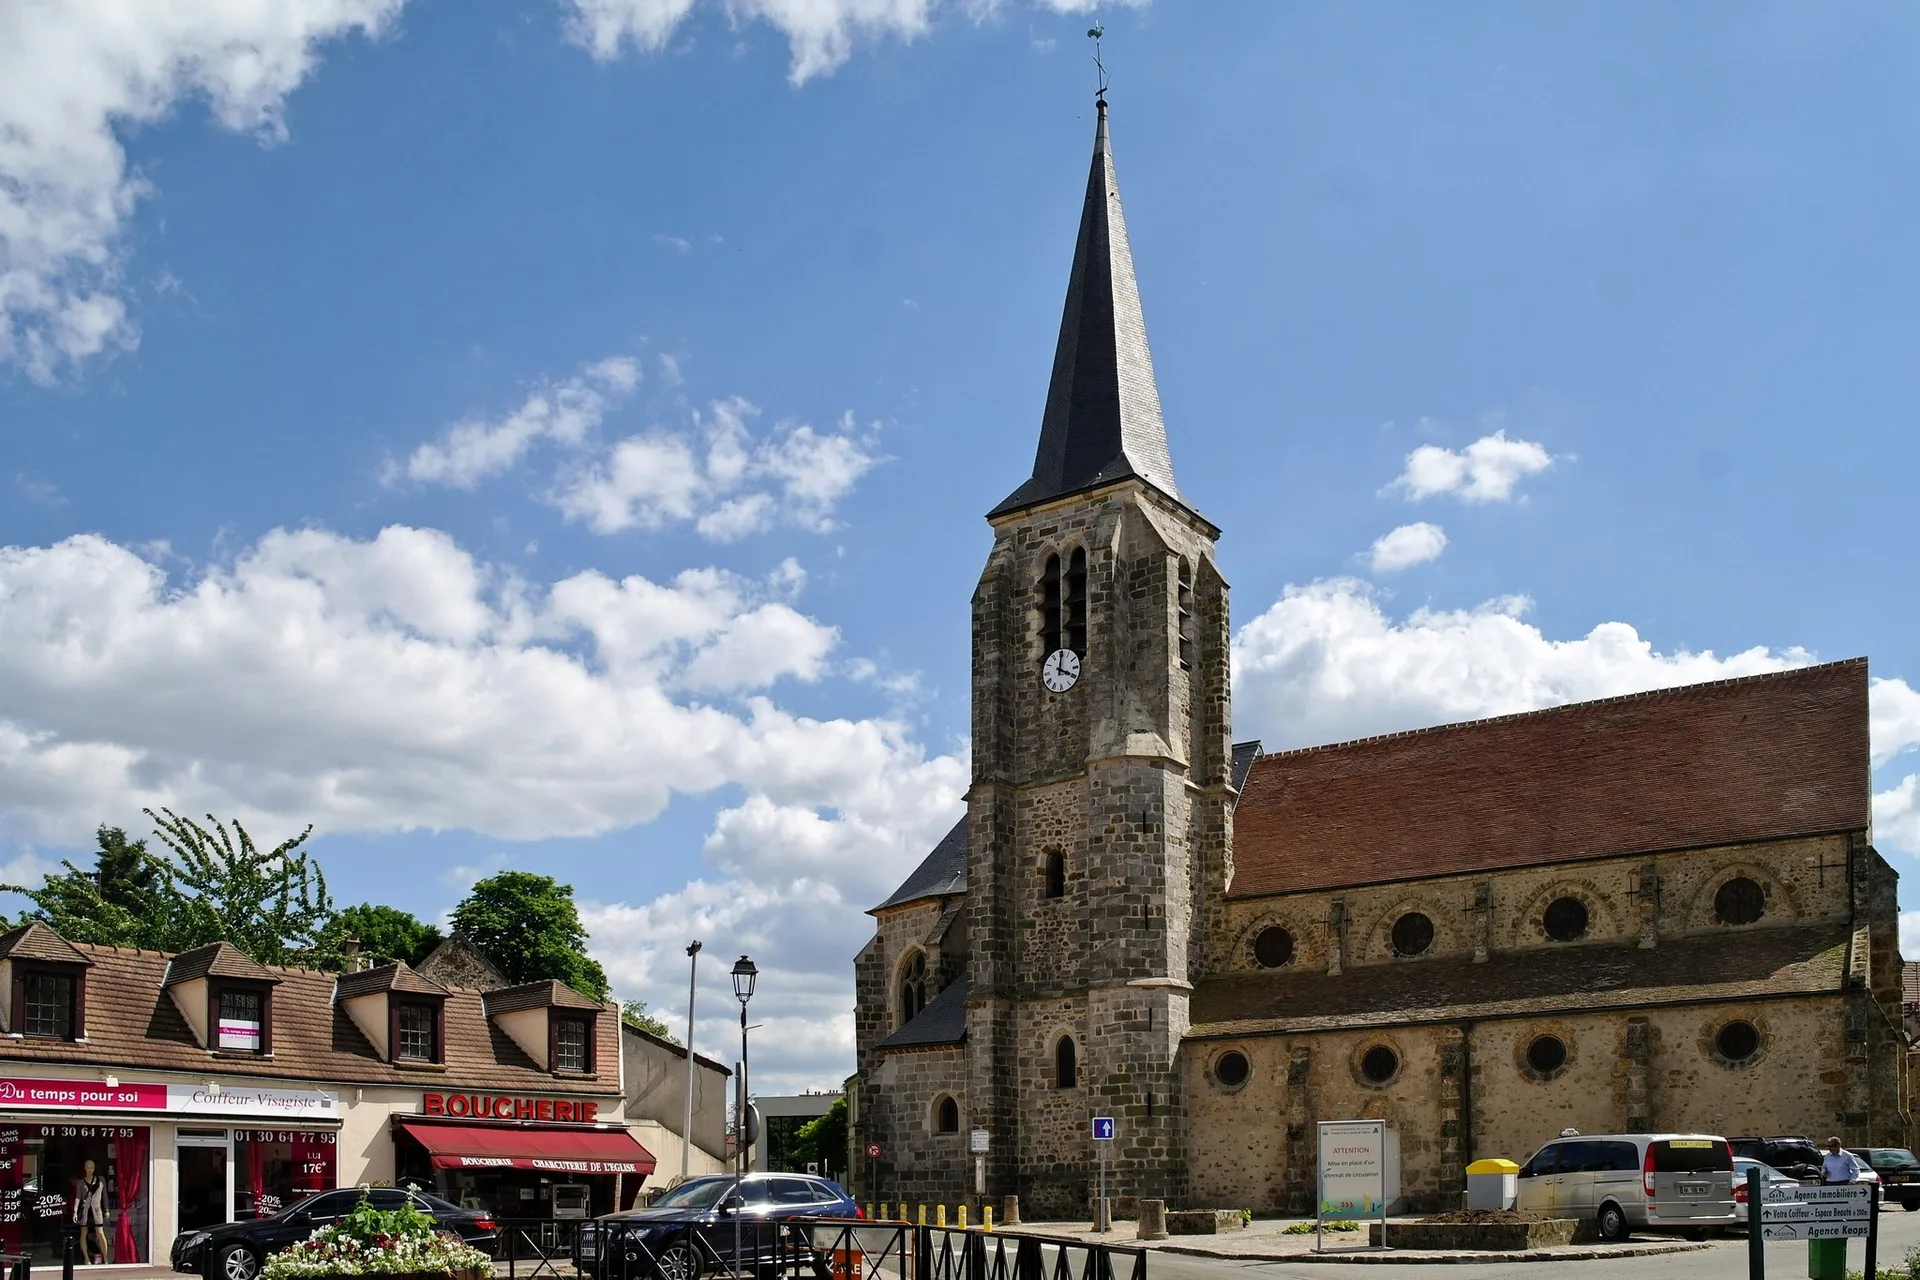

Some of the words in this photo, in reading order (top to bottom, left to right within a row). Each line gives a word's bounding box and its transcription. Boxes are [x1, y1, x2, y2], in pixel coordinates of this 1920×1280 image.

[0, 1081, 25, 1099] Du
[30, 1089, 76, 1102] temps
[80, 1092, 114, 1102] pour
[118, 1092, 138, 1102] soi
[424, 1093, 598, 1123] BOUCHERIE
[1, 1129, 19, 1137] SANS
[41, 1126, 56, 1136] 01
[61, 1127, 77, 1137] 30
[81, 1127, 96, 1137] 64
[101, 1128, 115, 1138] 77
[119, 1128, 134, 1138] 95
[235, 1130, 251, 1142] 01
[257, 1131, 274, 1142] 30
[278, 1131, 294, 1143] 64
[300, 1132, 315, 1143] 77
[320, 1133, 336, 1144] 95
[307, 1152, 321, 1160] LUI
[460, 1157, 514, 1166] BOUCHERIE
[532, 1160, 588, 1171] CHARCUTERIE
[590, 1163, 601, 1172] DE
[604, 1164, 636, 1172] L'EGLISE
[4, 1189, 22, 1199] 29€
[36, 1194, 63, 1205] -20%
[258, 1194, 281, 1204] -20%
[1794, 1190, 1817, 1201] Agence
[1819, 1188, 1858, 1199] Immobilière
[4, 1201, 22, 1211] 55€
[4, 1212, 22, 1222] 20€
[1773, 1209, 1788, 1219] Votre
[1788, 1208, 1810, 1218] Coiffeur
[1814, 1207, 1832, 1218] Espace
[1833, 1206, 1852, 1216] Beauté
[1807, 1226, 1840, 1237] Agence
[1841, 1224, 1868, 1236] Keops
